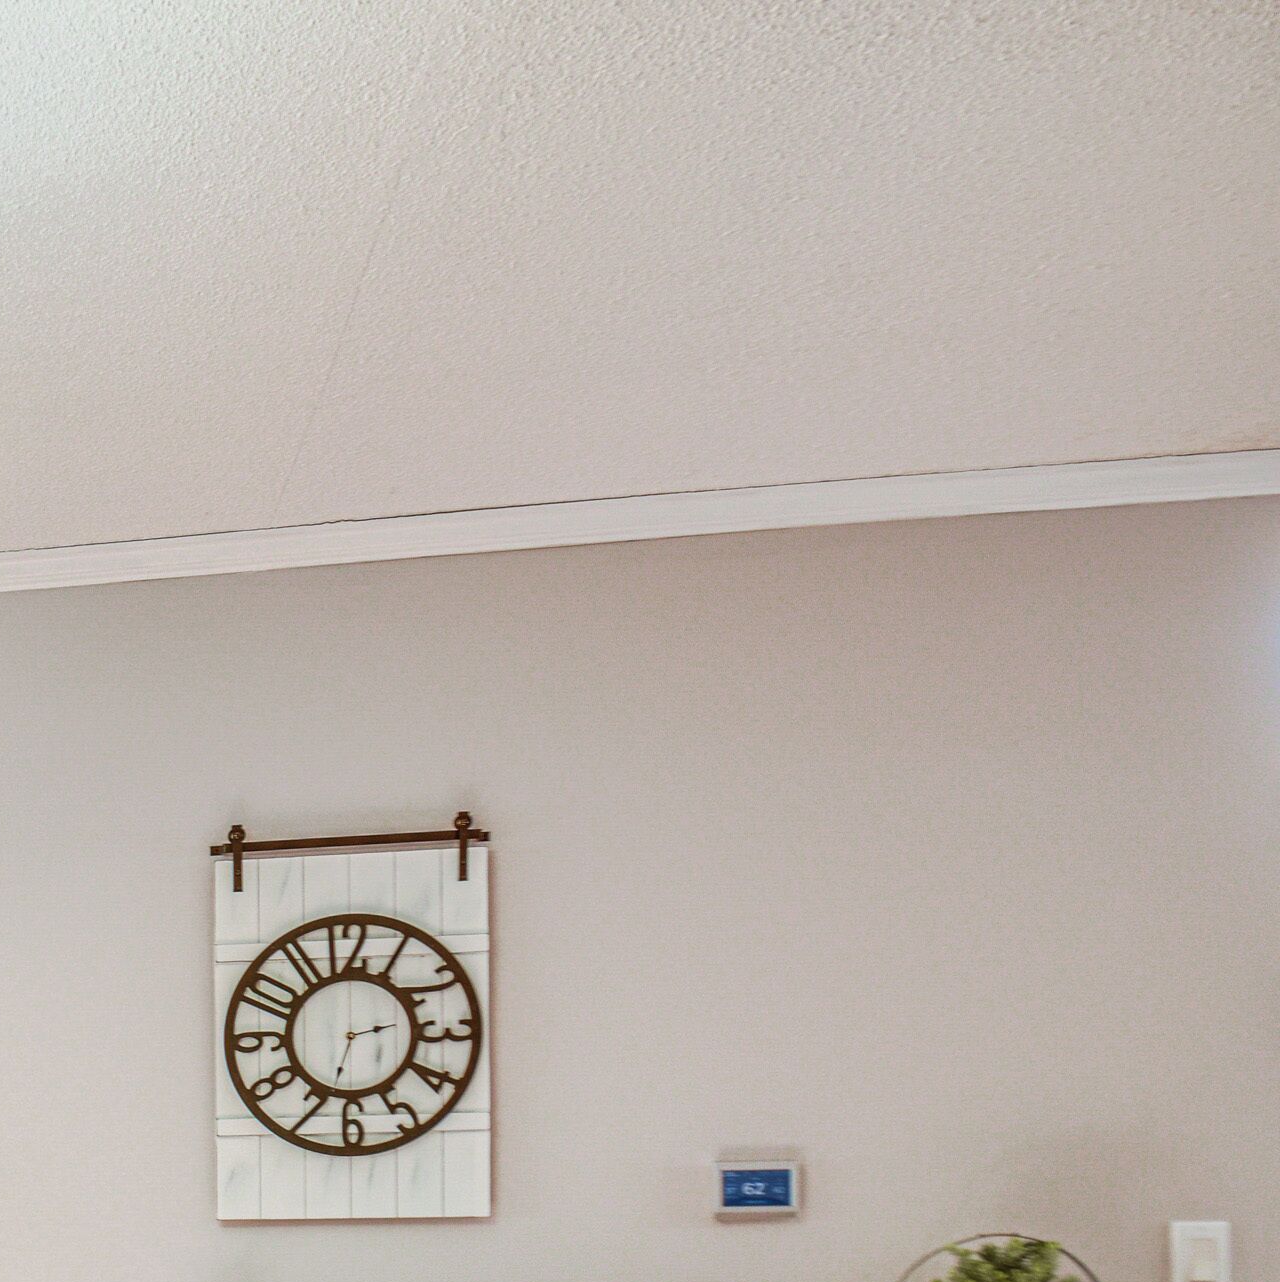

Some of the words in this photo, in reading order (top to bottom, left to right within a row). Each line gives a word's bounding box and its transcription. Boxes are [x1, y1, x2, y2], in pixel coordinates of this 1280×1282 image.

[281, 938, 323, 990] 11
[328, 924, 367, 977] 12
[379, 933, 411, 976] 1
[240, 972, 301, 1021] 10
[399, 964, 462, 1008] 2
[234, 1031, 287, 1053] 9
[417, 1019, 473, 1043] 3
[249, 1065, 297, 1102] 8
[409, 1063, 465, 1095] 4
[289, 1086, 328, 1134] 7
[342, 1099, 364, 1147] 6
[380, 1086, 421, 1135] 5
